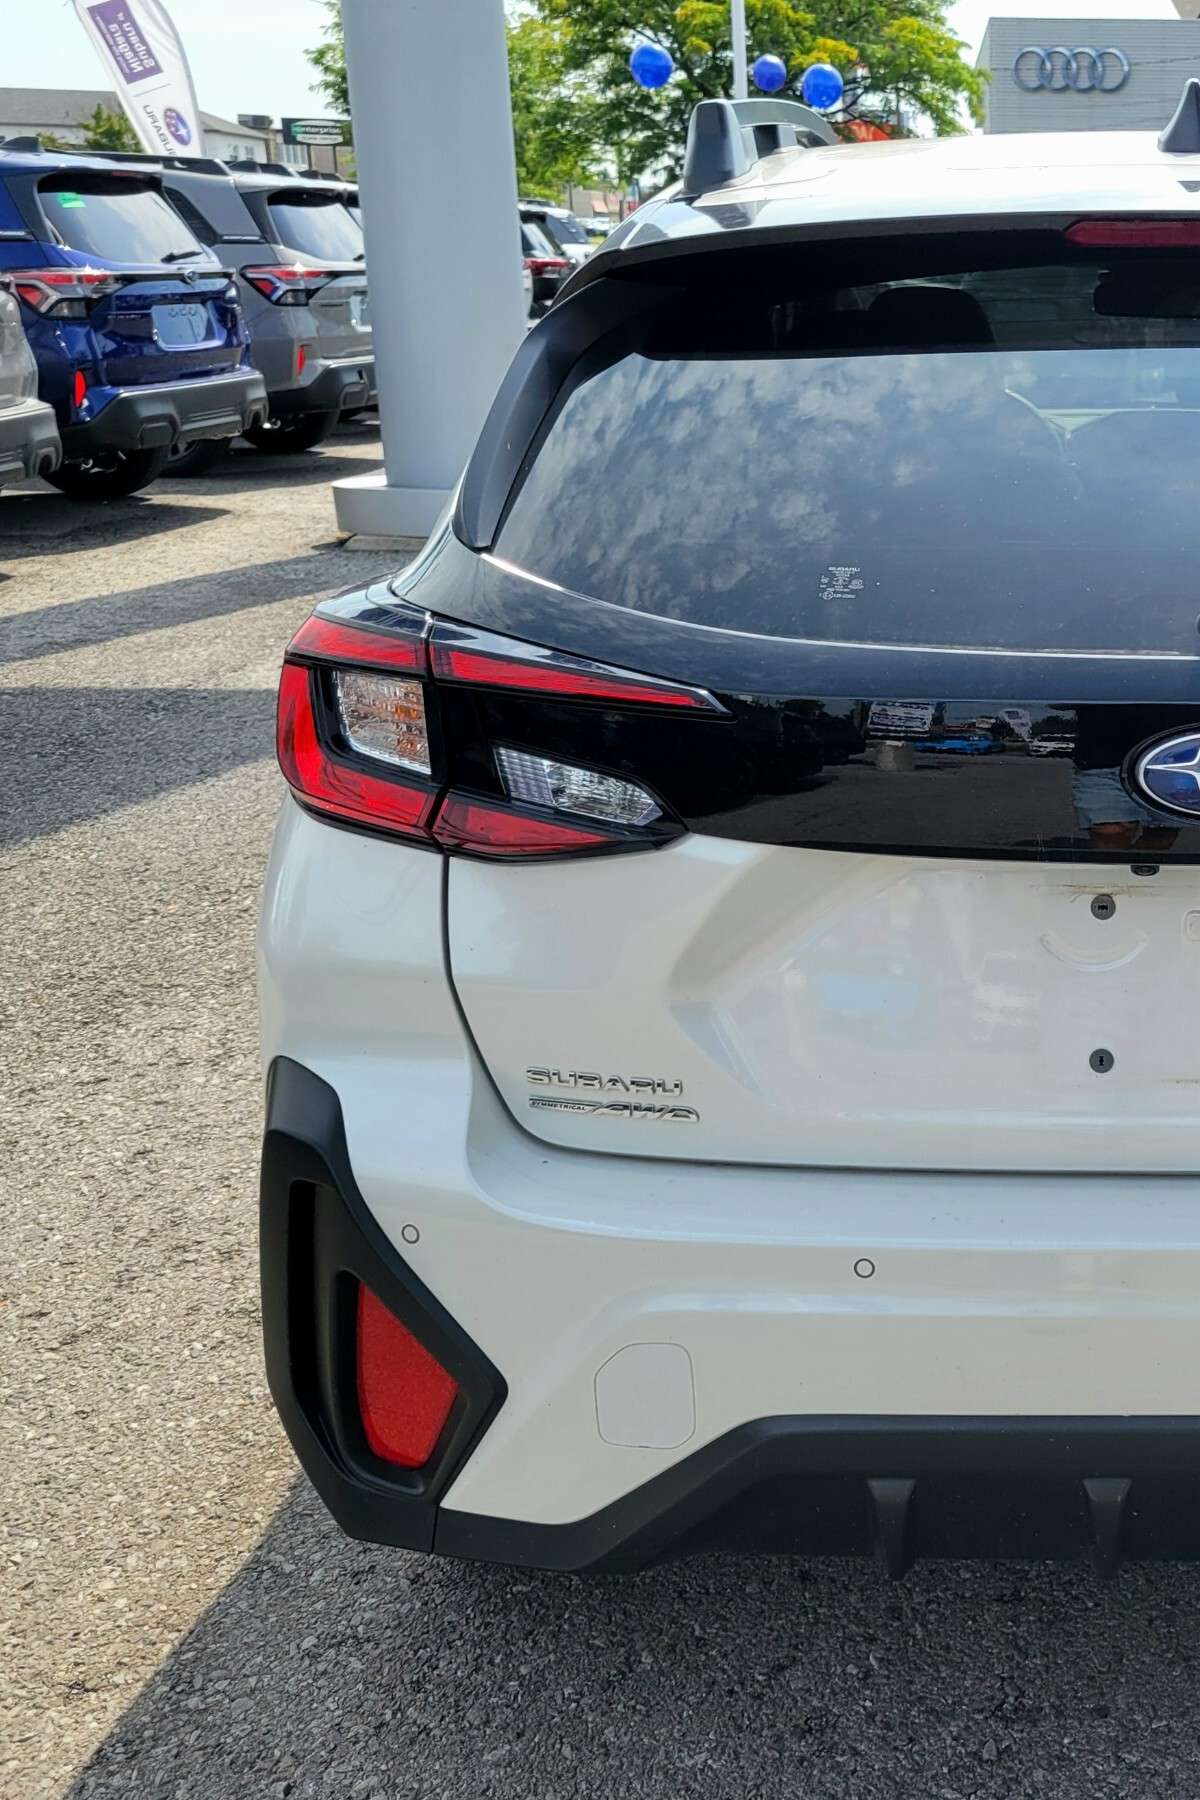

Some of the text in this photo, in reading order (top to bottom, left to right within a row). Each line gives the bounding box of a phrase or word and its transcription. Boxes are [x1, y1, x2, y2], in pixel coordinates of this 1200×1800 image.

[526, 1066, 684, 1097] SUBARU
[530, 1101, 700, 1123] SYMMETRICAL AWD
